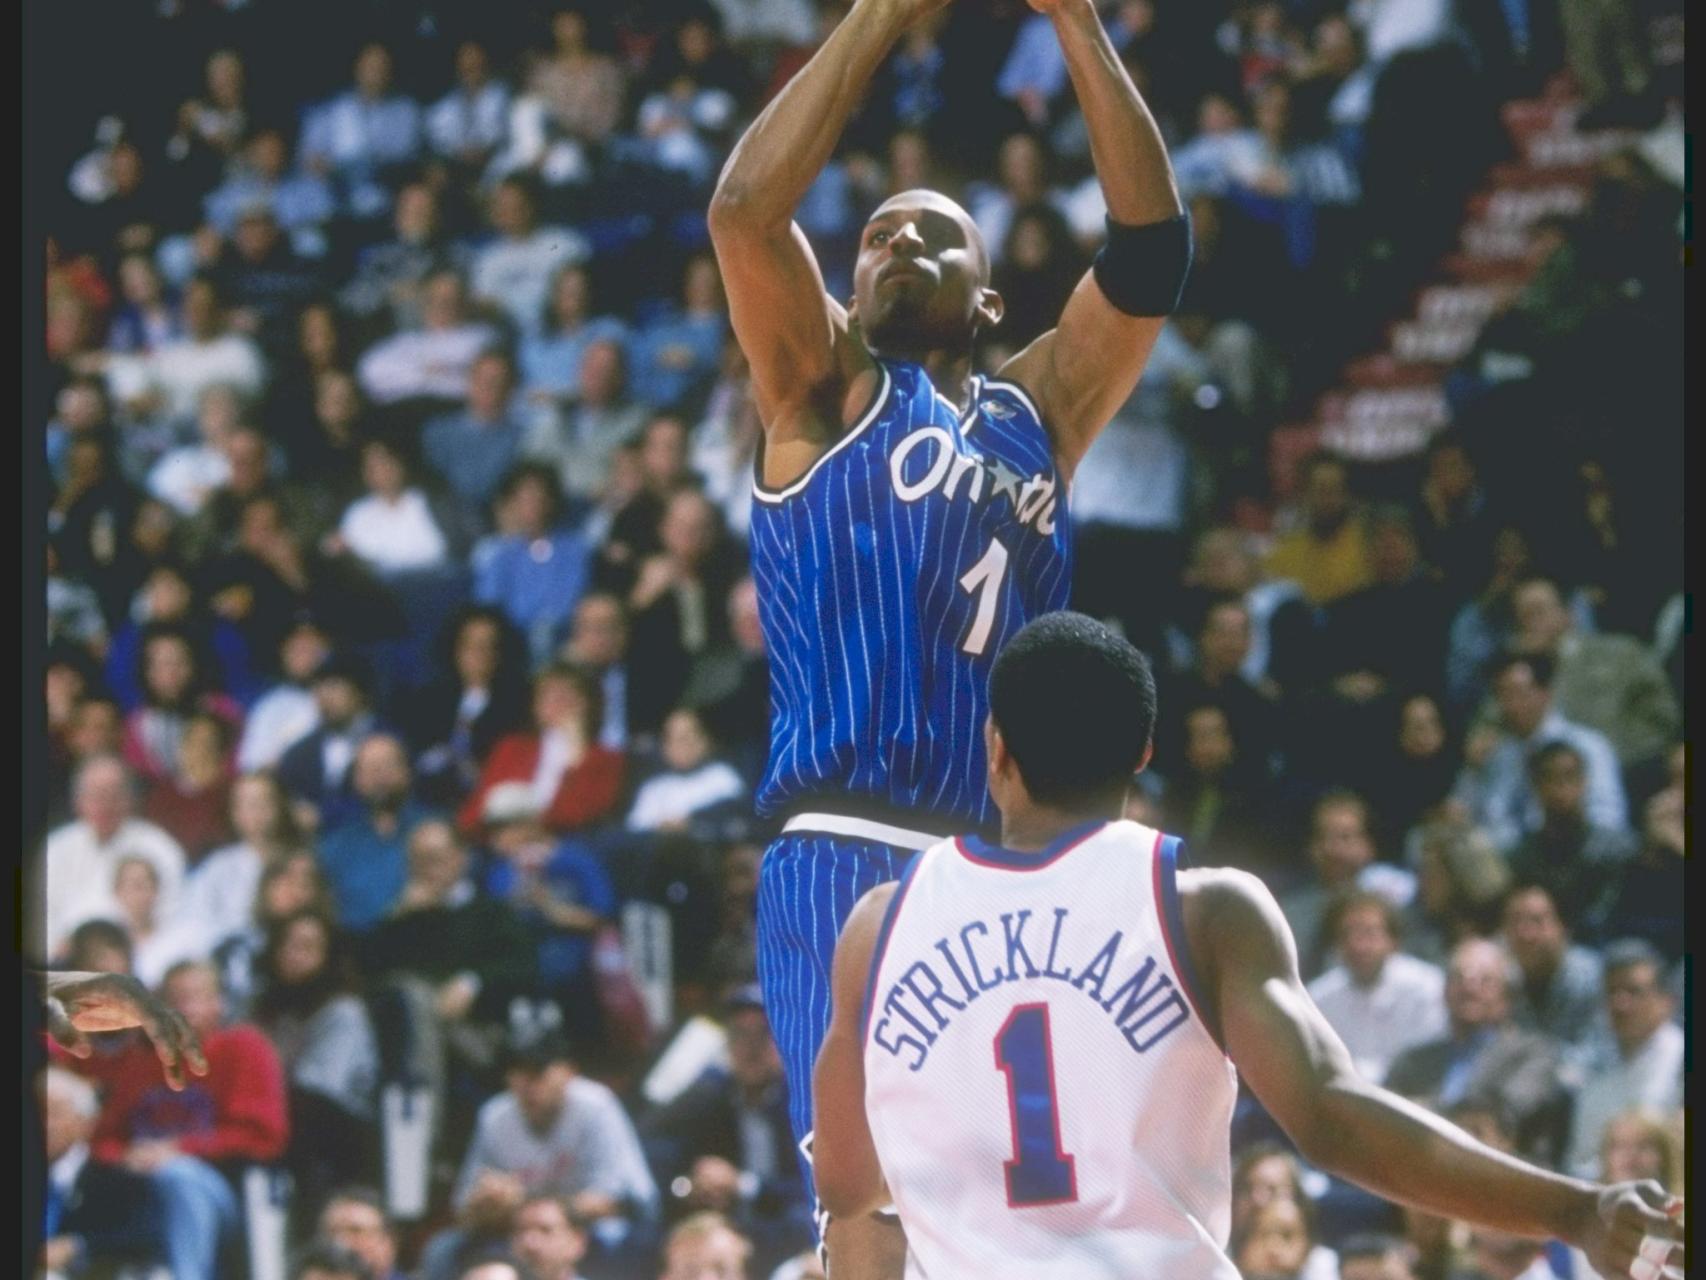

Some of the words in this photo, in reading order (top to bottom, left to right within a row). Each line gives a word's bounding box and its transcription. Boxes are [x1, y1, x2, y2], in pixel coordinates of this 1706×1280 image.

[959, 537, 1008, 655] 1
[873, 907, 1190, 1072] STRICKLAND
[993, 1001, 1079, 1209] 1
